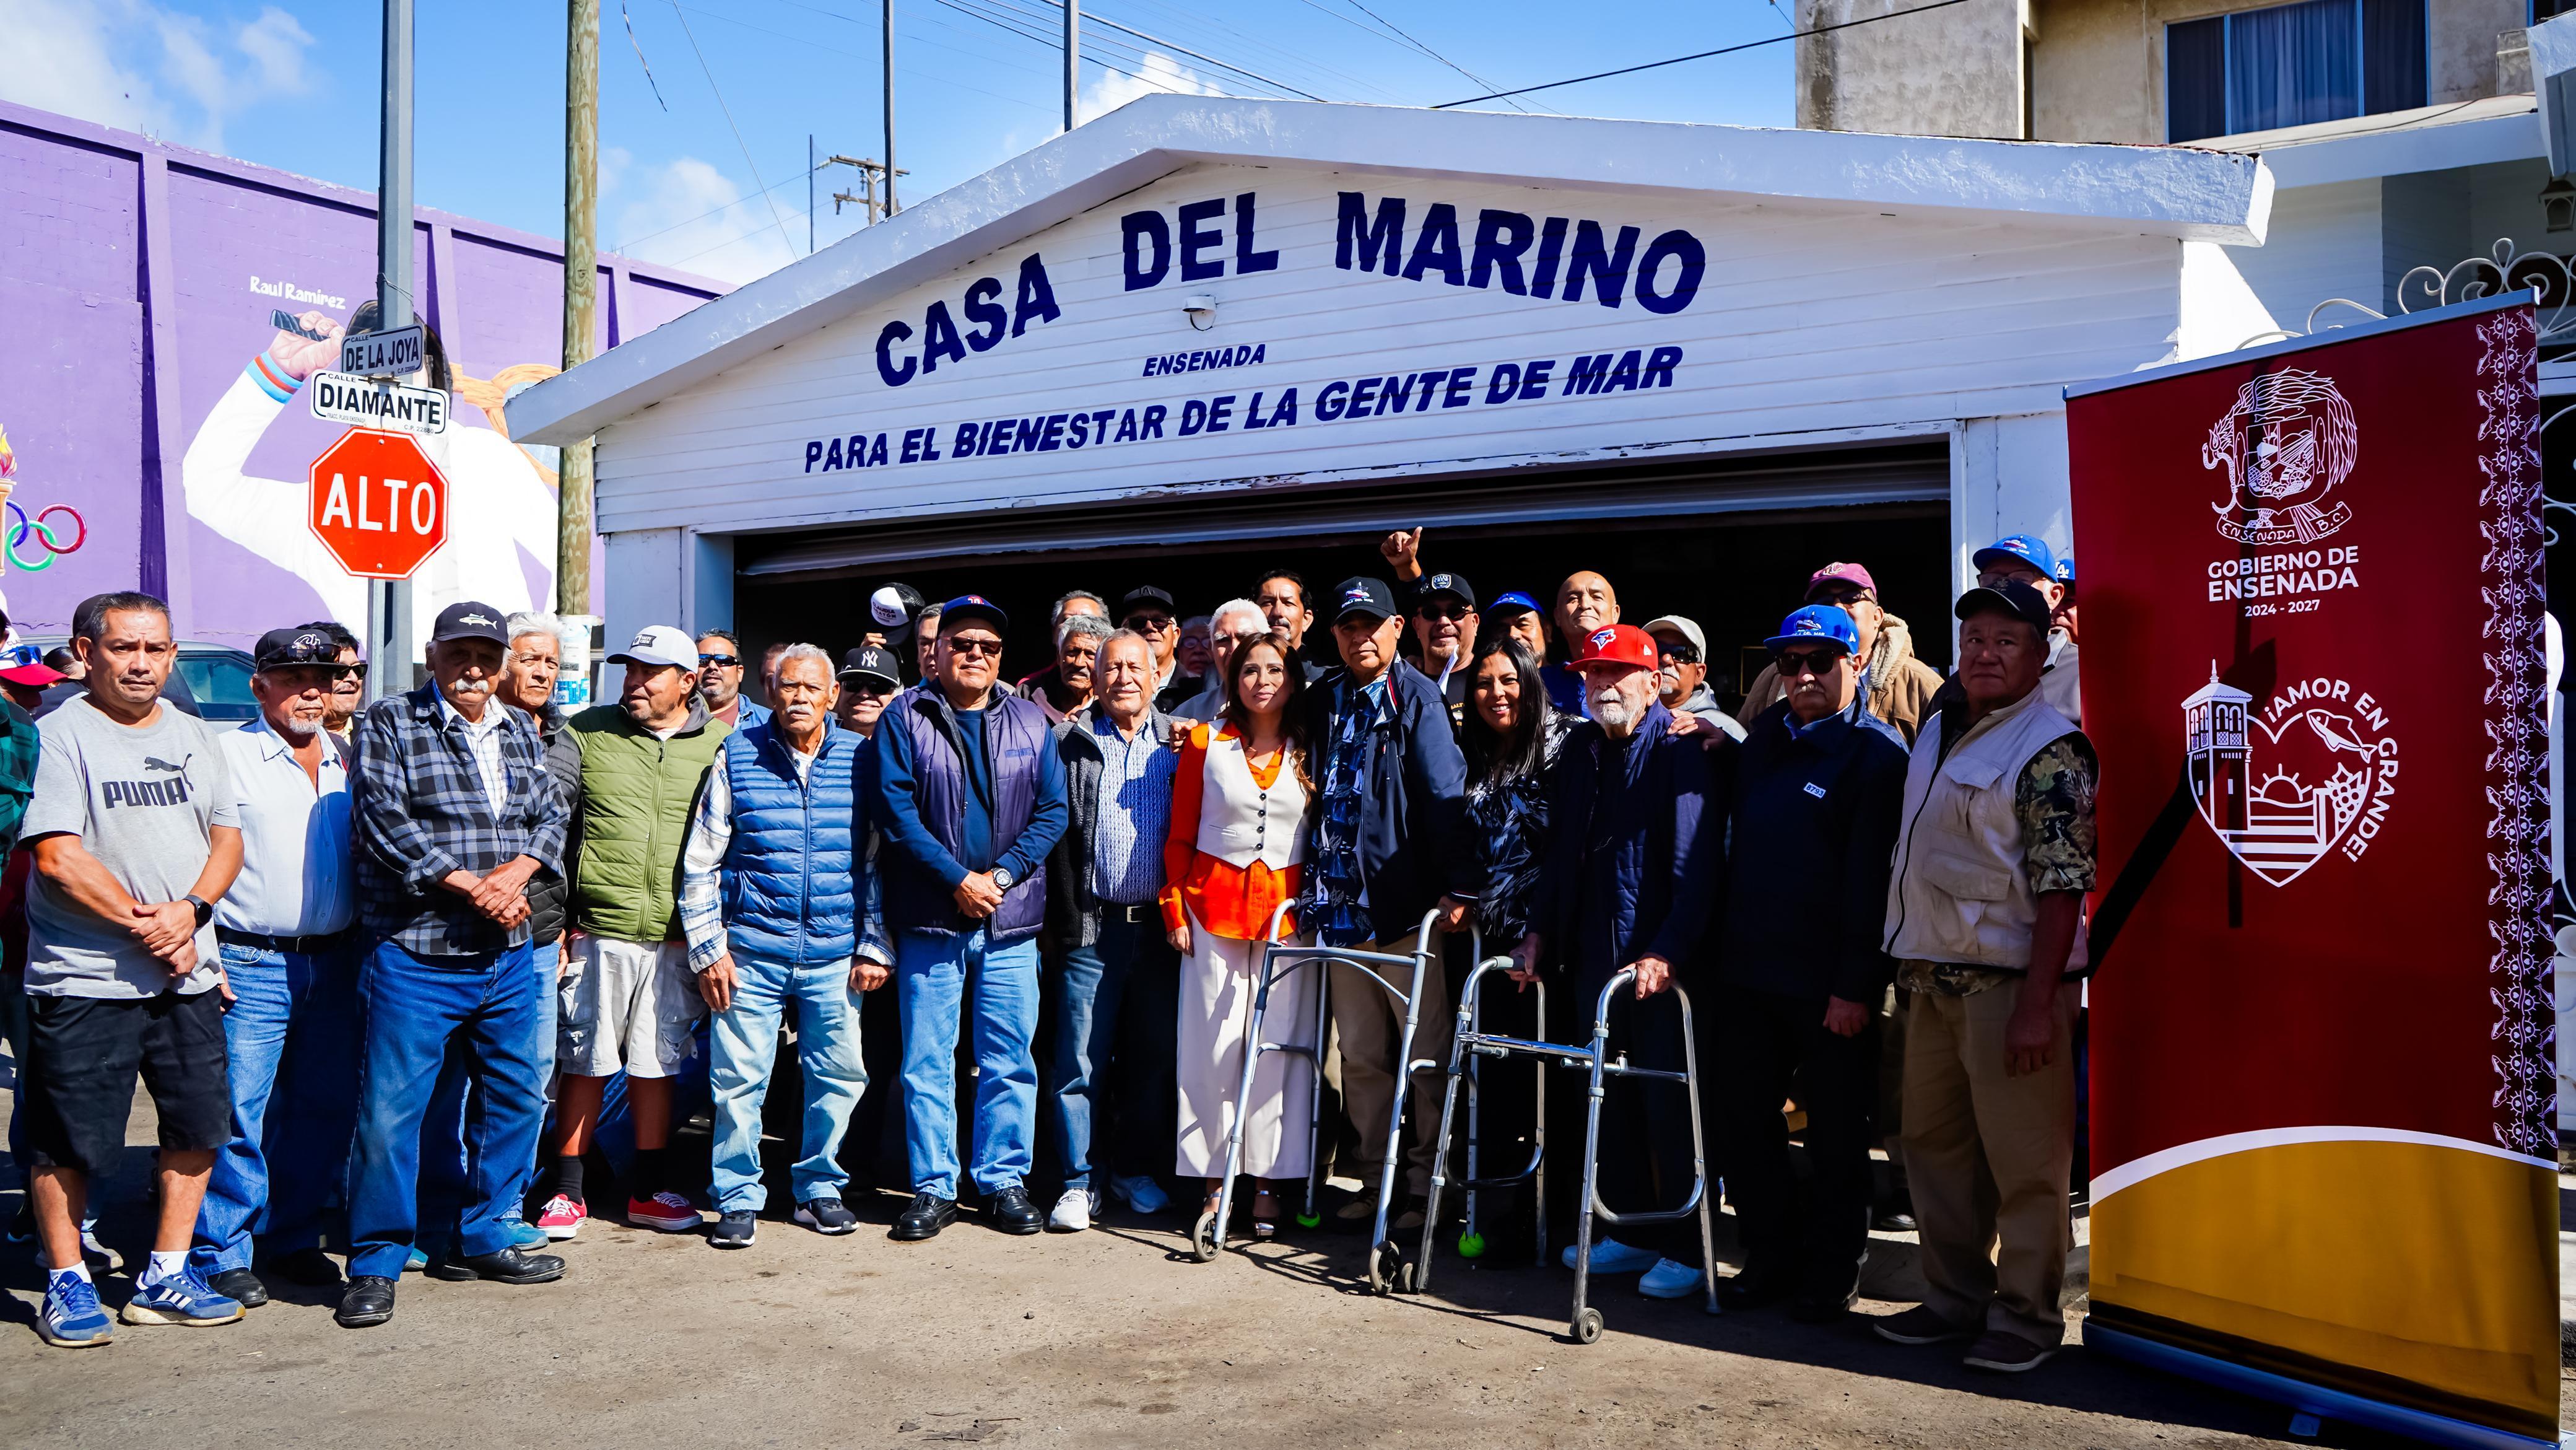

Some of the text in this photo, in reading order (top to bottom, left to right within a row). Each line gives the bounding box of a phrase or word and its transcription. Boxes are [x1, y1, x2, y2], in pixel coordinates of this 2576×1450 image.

[250, 276, 346, 309] Raul Ramirez
[875, 191, 1706, 387] CASA DEL MARINO
[346, 336, 419, 372] DE LA JOYA
[1142, 344, 1266, 377] ENSENADA
[328, 373, 357, 383] CALLE
[320, 383, 441, 425] DIAMANTE
[804, 346, 1683, 474] PARA EL BIENESTAR DE LA GENTE DE MAR
[321, 473, 436, 535] ALTO
[2222, 512, 2344, 541] ENSENADA B.C.
[2208, 546, 2359, 579] GOBIERNO DE
[2208, 566, 2359, 602] ENSENADA
[2245, 603, 2277, 617] 2024
[2288, 599, 2320, 613] 2027
[2264, 678, 2399, 863] ¡AMOR EN GRANDE!
[102, 777, 188, 808] PUMA
[1806, 784, 1824, 797] 8793
